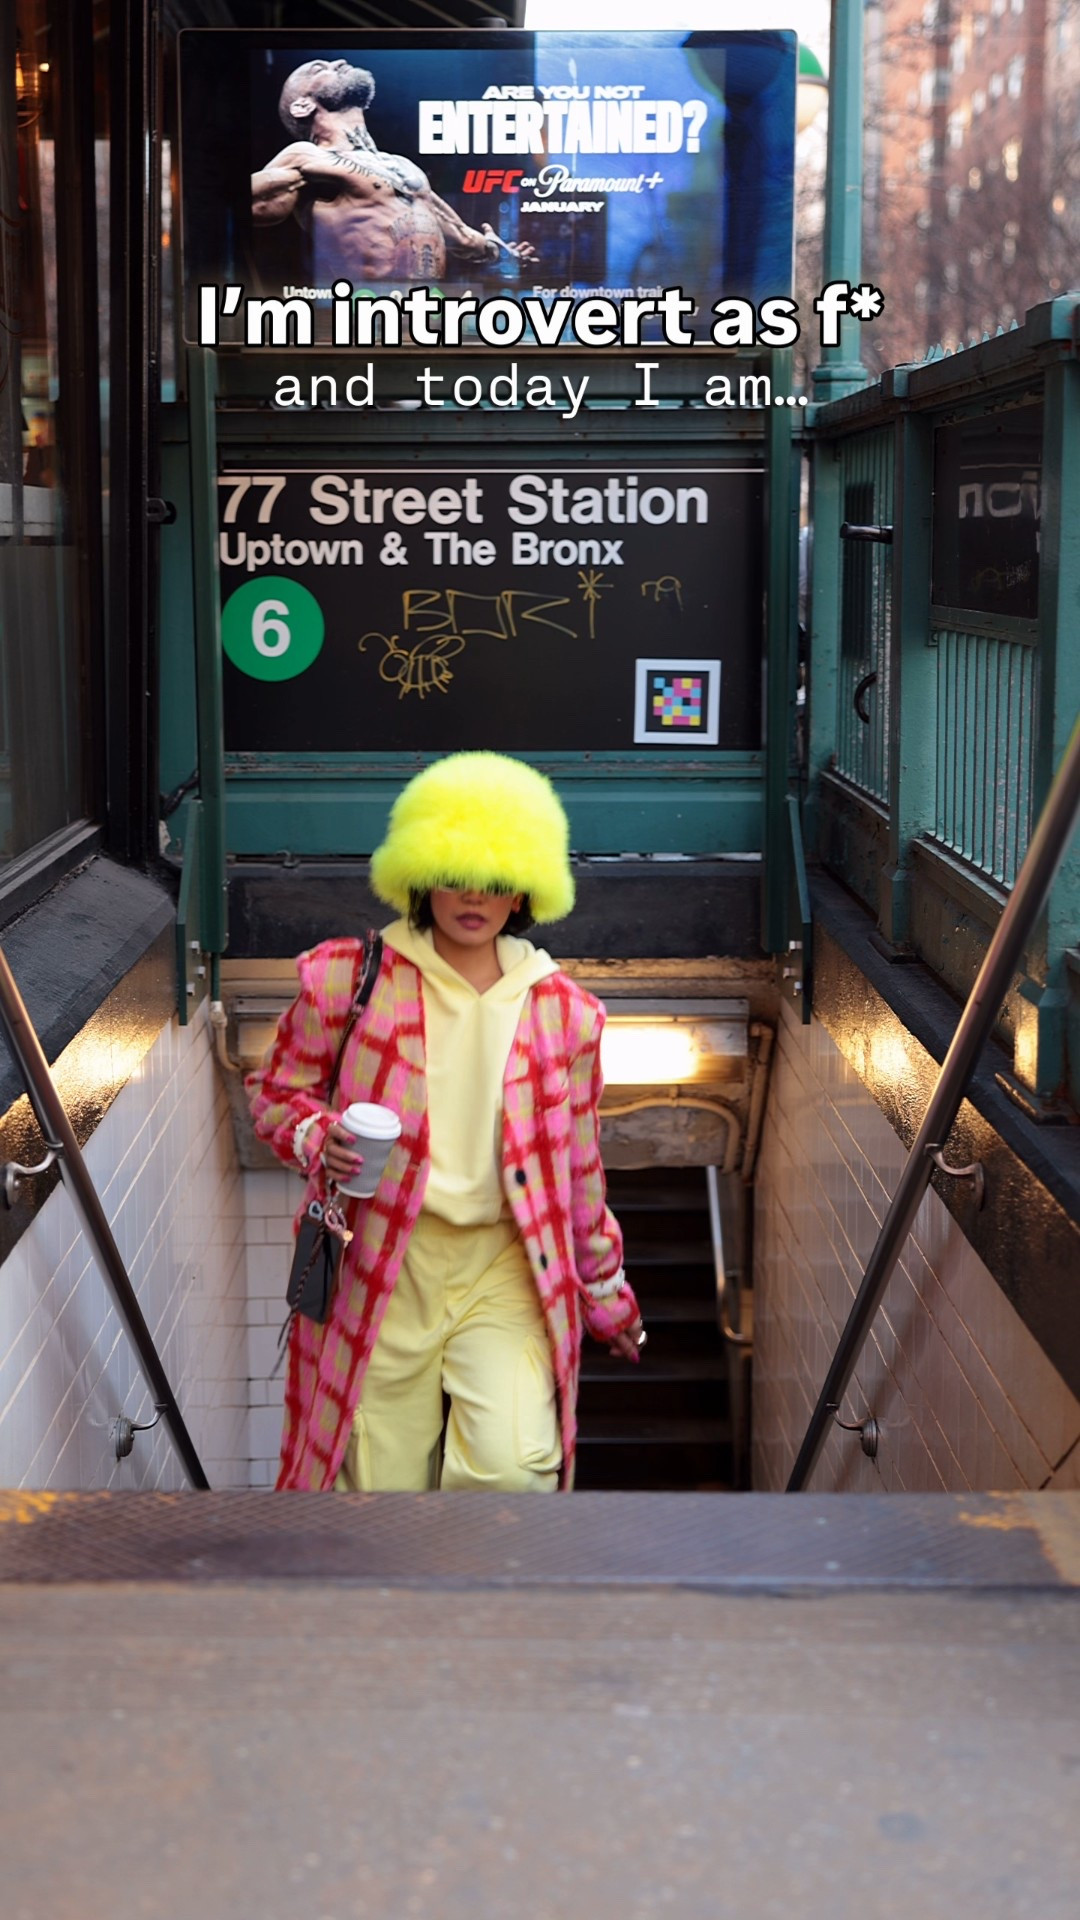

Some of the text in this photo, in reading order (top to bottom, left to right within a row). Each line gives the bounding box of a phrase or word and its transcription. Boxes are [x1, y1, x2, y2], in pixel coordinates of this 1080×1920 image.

[482, 85, 646, 99] ARE YOU NOT
[418, 99, 708, 154] ENTERTAINED?
[462, 163, 664, 198] UFC ON Paramount+
[520, 201, 605, 213] JANUARY
[532, 285, 558, 299] For
[560, 285, 635, 299] downtown
[217, 474, 709, 526] 77 Street Station
[219, 531, 625, 572] Uptown & The Bronx
[250, 599, 292, 658] 6
